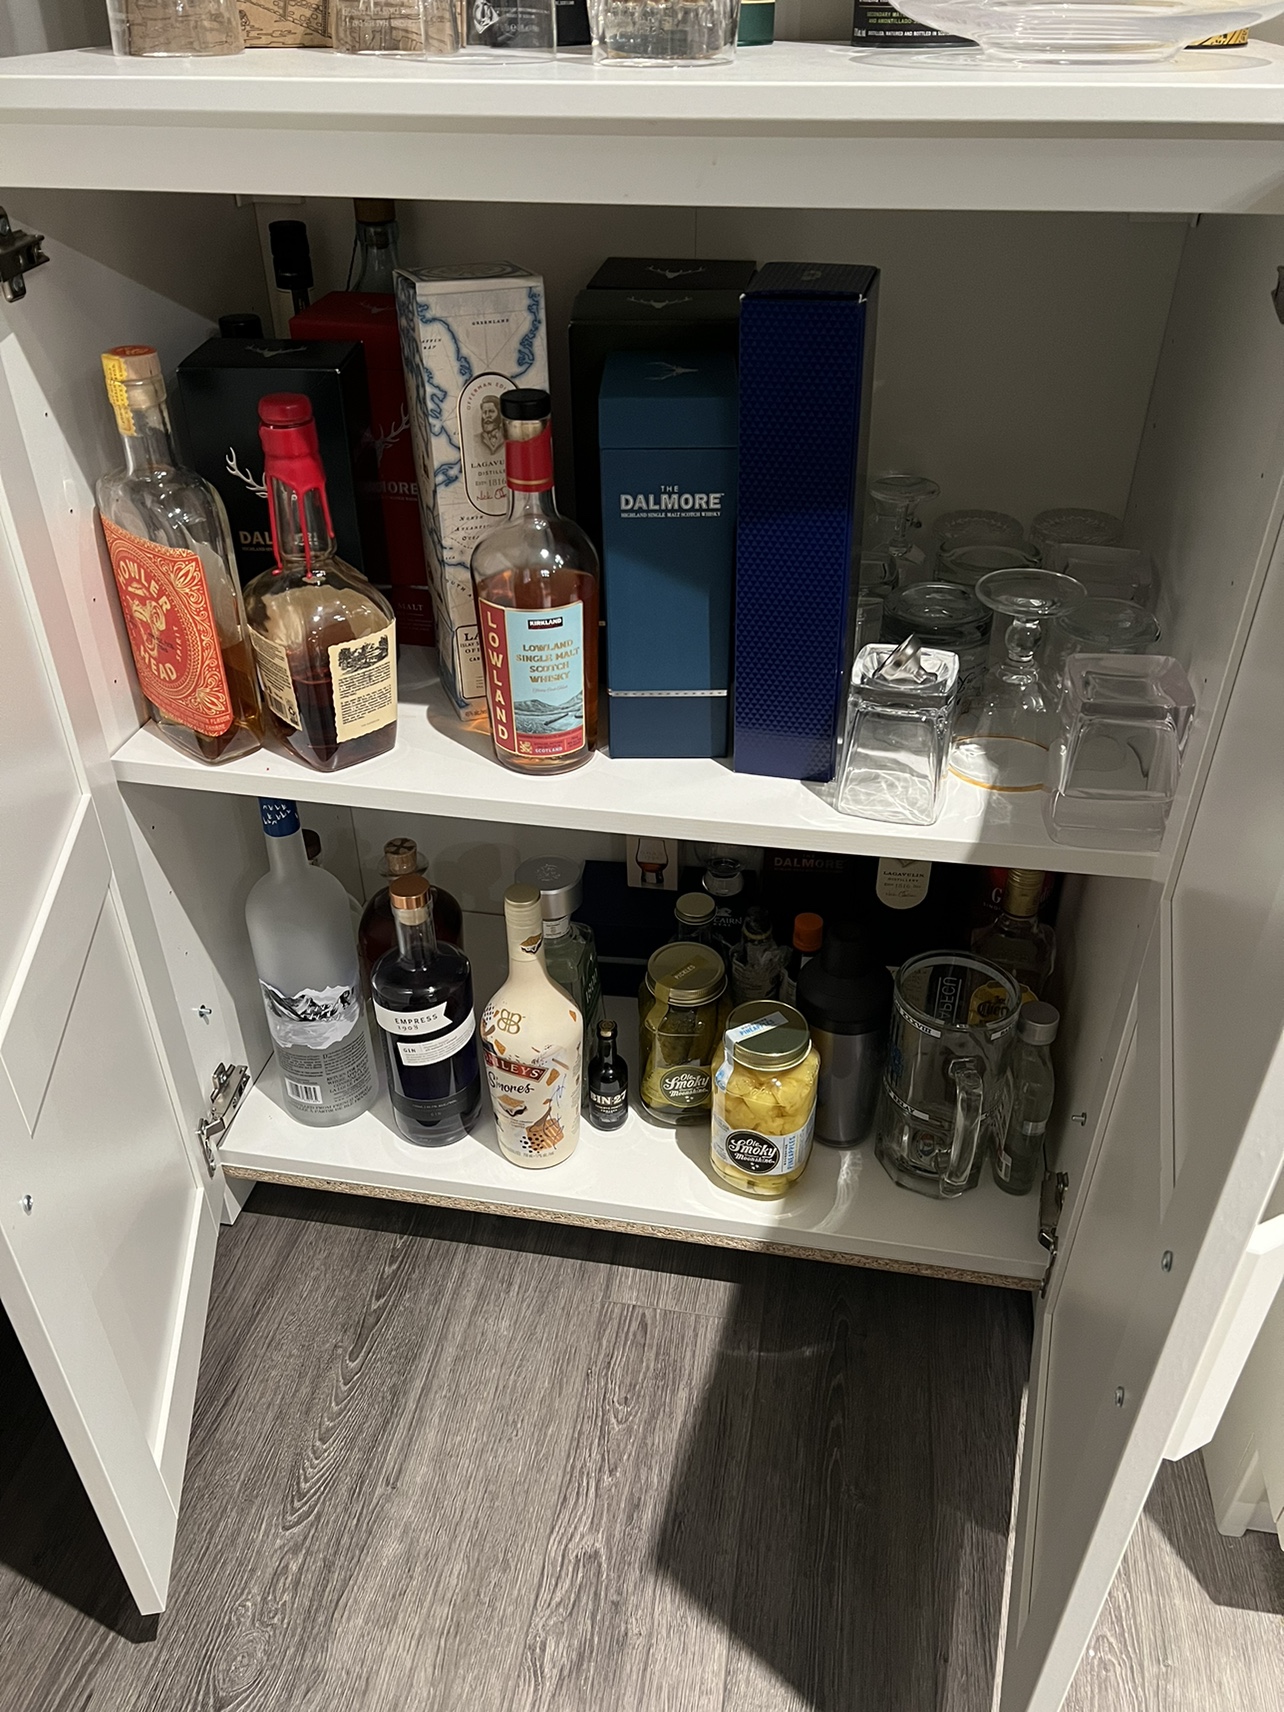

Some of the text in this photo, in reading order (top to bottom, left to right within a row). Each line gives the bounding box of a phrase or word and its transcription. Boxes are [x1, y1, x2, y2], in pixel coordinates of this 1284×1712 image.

[466, 382, 492, 411] OFFERMAN
[471, 460, 505, 469] LAGAVU
[620, 493, 722, 510] DALMORE
[239, 531, 272, 545] DAL
[118, 559, 171, 613] HOWLER
[529, 617, 562, 627] KIRKLAND
[173, 626, 182, 662] SPIRIT
[522, 639, 573, 652] LOWLAND
[515, 647, 580, 663] SINGLE MALT
[140, 646, 177, 681] HEAD
[529, 661, 569, 673] SCOTCH
[487, 611, 509, 741] LOWLAND
[529, 671, 570, 683] WHISKY
[773, 857, 845, 870] DALMORE
[674, 964, 696, 980] PICKLES
[395, 1013, 438, 1025] EMPRESS
[663, 1075, 710, 1090] Smoky
[680, 1073, 697, 1081] Ole
[590, 1089, 626, 1105] BIN 27
[669, 1088, 708, 1097] Moonshine
[728, 1139, 777, 1159] Smoky
[745, 1138, 762, 1148] Ole
[734, 1152, 775, 1164] Moonshine
[787, 1135, 796, 1170] PINEAPPLES
